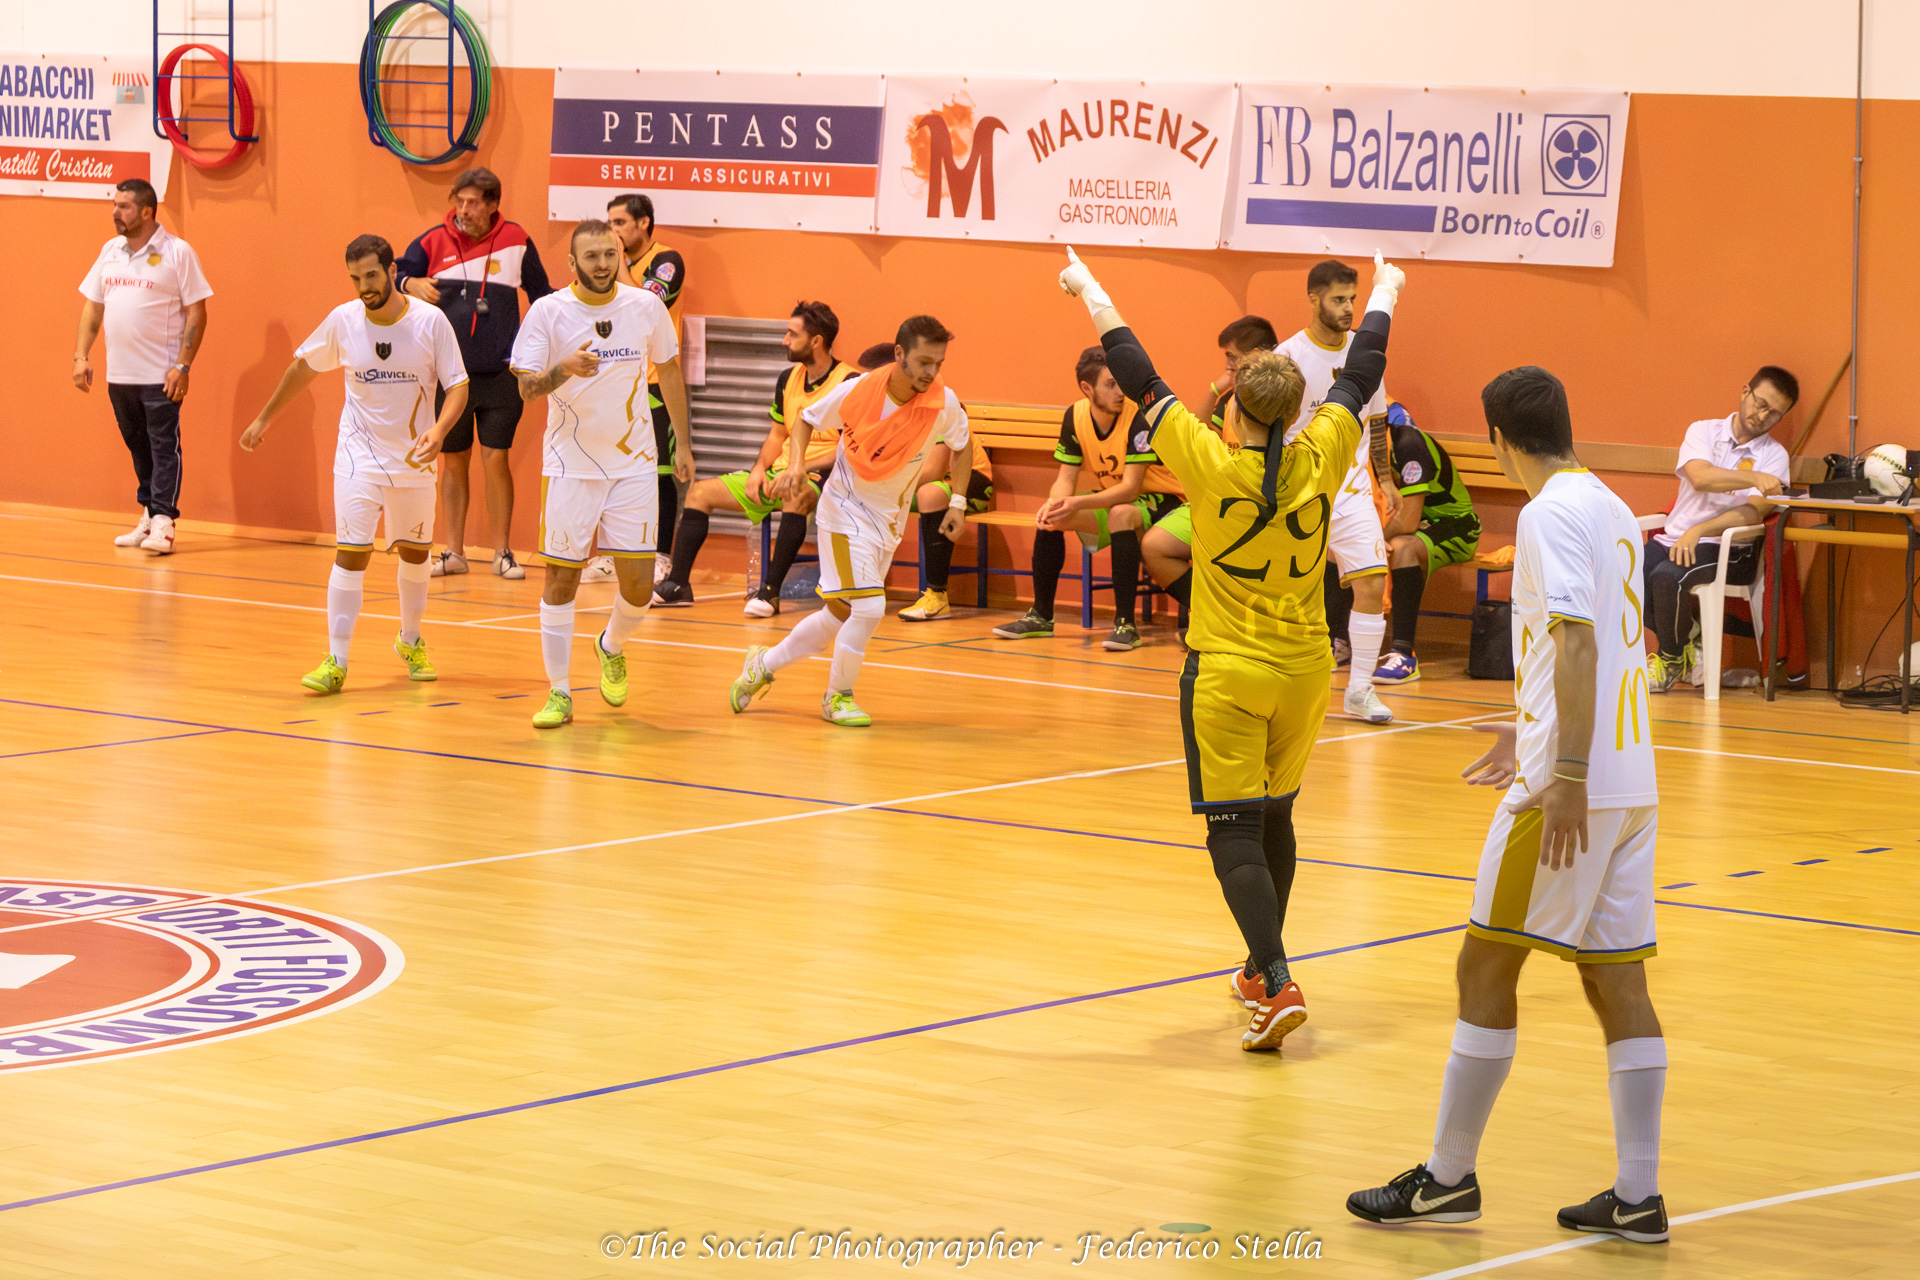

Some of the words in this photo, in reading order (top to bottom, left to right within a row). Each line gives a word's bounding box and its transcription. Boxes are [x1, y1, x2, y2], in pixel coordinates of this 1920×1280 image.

[0, 64, 94, 100] ABACCHI
[0, 105, 112, 141] NIMARKET
[602, 111, 832, 150] PENTASS
[1026, 99, 1219, 169] MAURENZI
[1248, 104, 1311, 187] FB
[1330, 108, 1522, 195] Balzanelli
[0, 150, 40, 175] atelli
[46, 149, 113, 181] Cristian
[601, 164, 674, 182] SERVIZI
[691, 167, 830, 188] ASSICURATIVI
[1069, 178, 1172, 201] MACELLERIA
[1059, 203, 1178, 227] GASTRONOMIA
[410, 521, 424, 539] 4
[1211, 493, 1331, 582] 29
[1209, 813, 1239, 822] BART
[0, 954, 349, 1063] FOSSOMB
